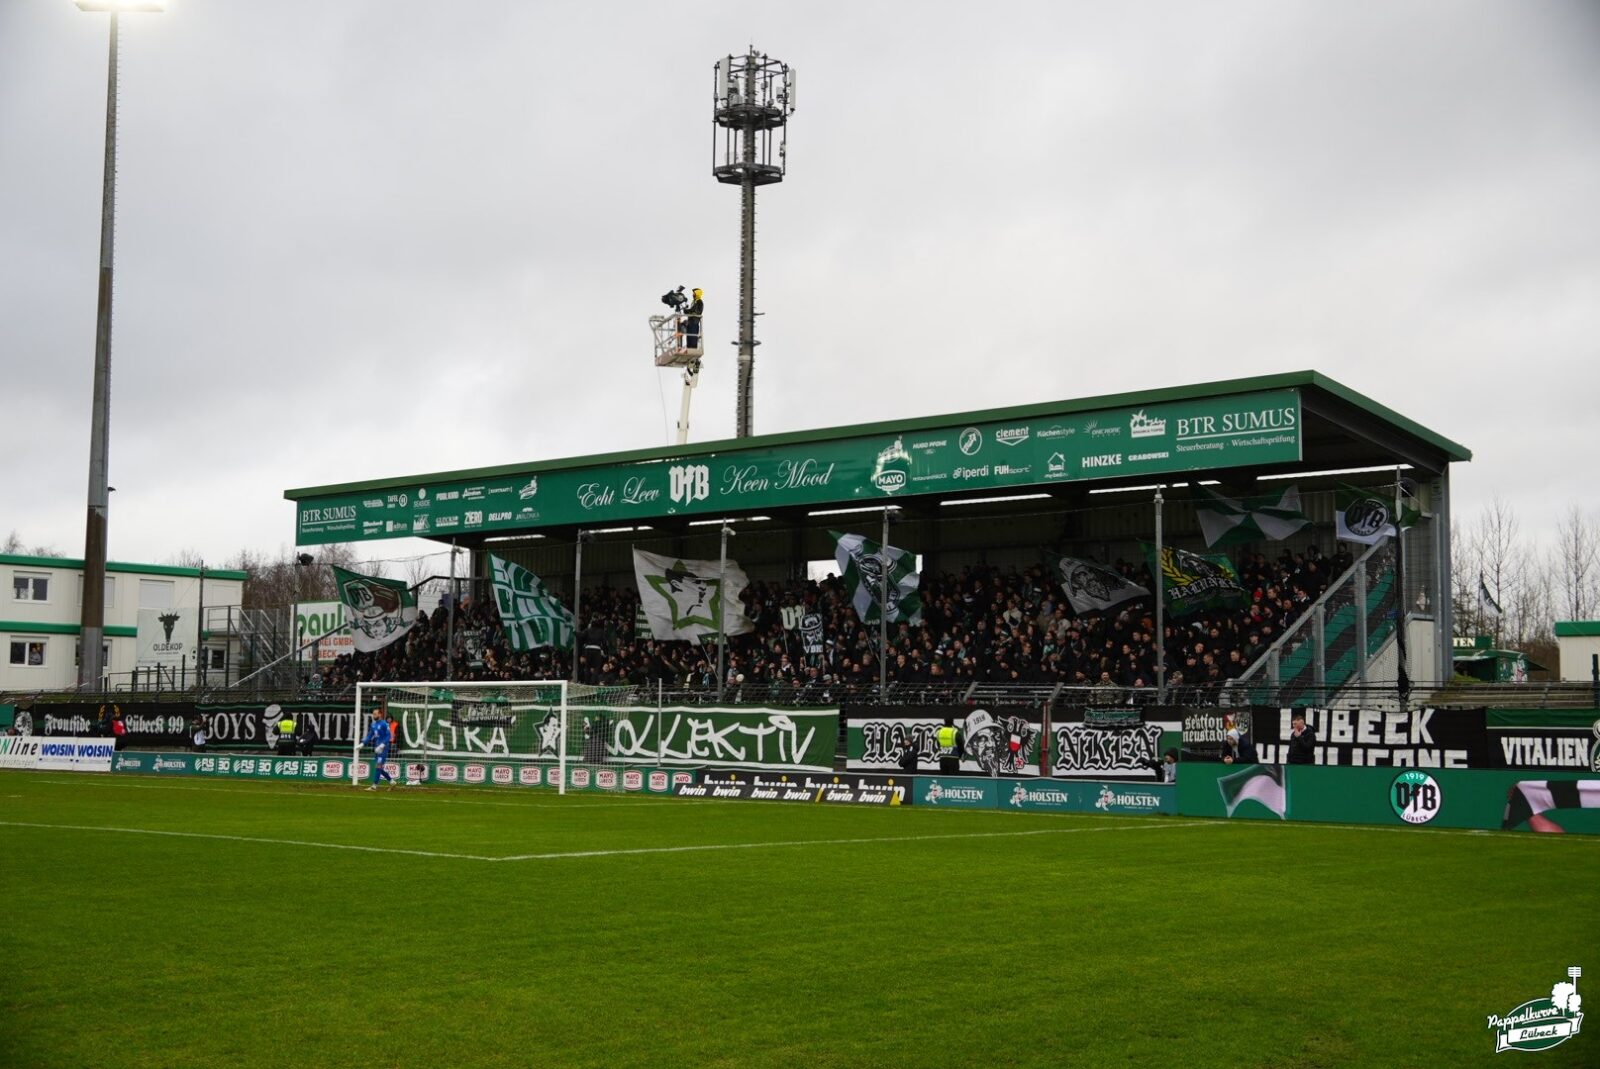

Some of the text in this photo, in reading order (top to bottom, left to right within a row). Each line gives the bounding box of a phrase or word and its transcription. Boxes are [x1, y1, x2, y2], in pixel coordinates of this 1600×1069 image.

[1176, 416, 1216, 436] BTR
[1222, 407, 1295, 431] SUMUS
[1176, 434, 1295, 452] Steuerberatung Wirtschaftsprüfung
[1082, 454, 1122, 468] HINZKE
[577, 482, 615, 509] Echt
[720, 464, 770, 495] Keen
[774, 458, 835, 490] Mood
[878, 473, 903, 485] MAYO
[303, 505, 357, 522] BTR SUMUS
[308, 649, 337, 659] LBECK
[168, 715, 184, 735] 99
[584, 712, 816, 765] OLLEKTIV
[0, 737, 39, 755] Nline
[41, 744, 75, 756] WOISIN
[78, 745, 113, 757] WOISIN
[1500, 736, 1589, 768] VITALIEN
[217, 760, 230, 771] 30
[258, 762, 271, 772] 30
[303, 763, 318, 773] 30
[1405, 772, 1425, 781] 1919
[679, 784, 706, 796] bwin
[712, 786, 741, 797] bwin
[751, 787, 779, 799] bwin
[783, 789, 811, 800] bwin
[826, 790, 853, 802] bwin
[944, 788, 984, 800] HOLSTEN
[859, 791, 886, 803] bwin
[1029, 790, 1068, 803] HOLSTEN
[1117, 794, 1160, 807] HOLSTEN
[1401, 813, 1428, 822] LÜBECK
